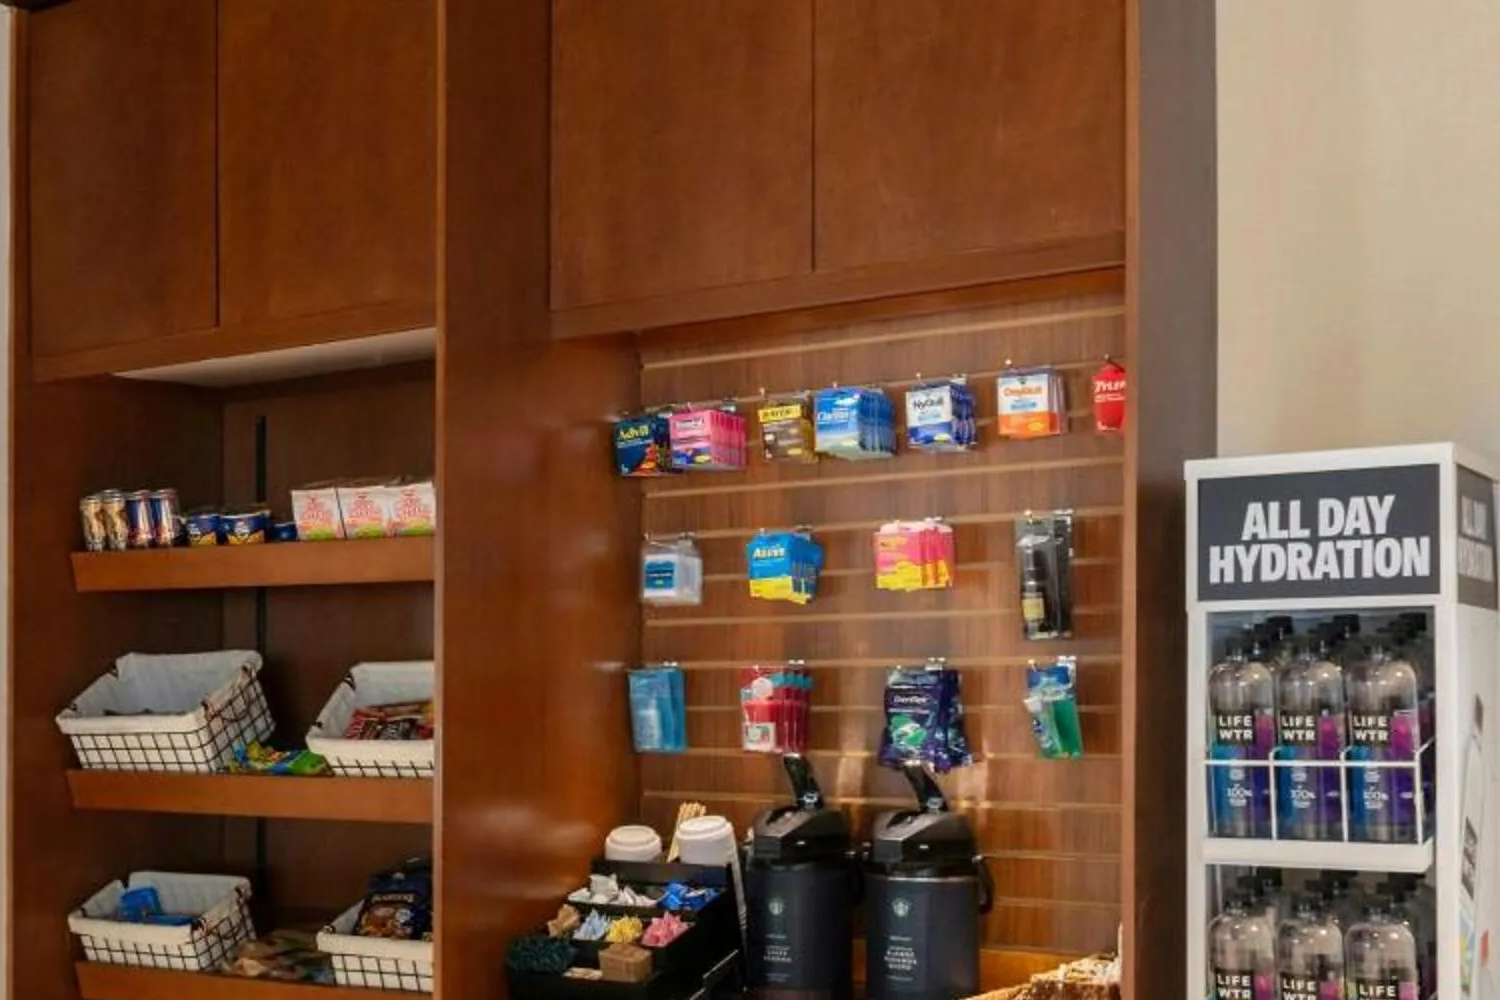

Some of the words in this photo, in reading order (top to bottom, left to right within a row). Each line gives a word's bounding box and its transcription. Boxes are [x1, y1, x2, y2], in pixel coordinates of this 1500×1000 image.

[1241, 499, 1311, 540] ALL
[1317, 494, 1396, 538] DAY
[1208, 536, 1431, 584] HYDRATION
[1219, 715, 1252, 727] LIFE
[1281, 715, 1315, 727] LIFE
[1353, 715, 1388, 727] LIFE
[1219, 729, 1253, 740] WTR
[1283, 729, 1316, 741] WTR
[1354, 729, 1388, 741] WTR
[1217, 974, 1250, 986] LIFE
[1283, 978, 1316, 991] LIFE
[1218, 988, 1252, 999] WTR
[1359, 984, 1396, 996] LIFE
